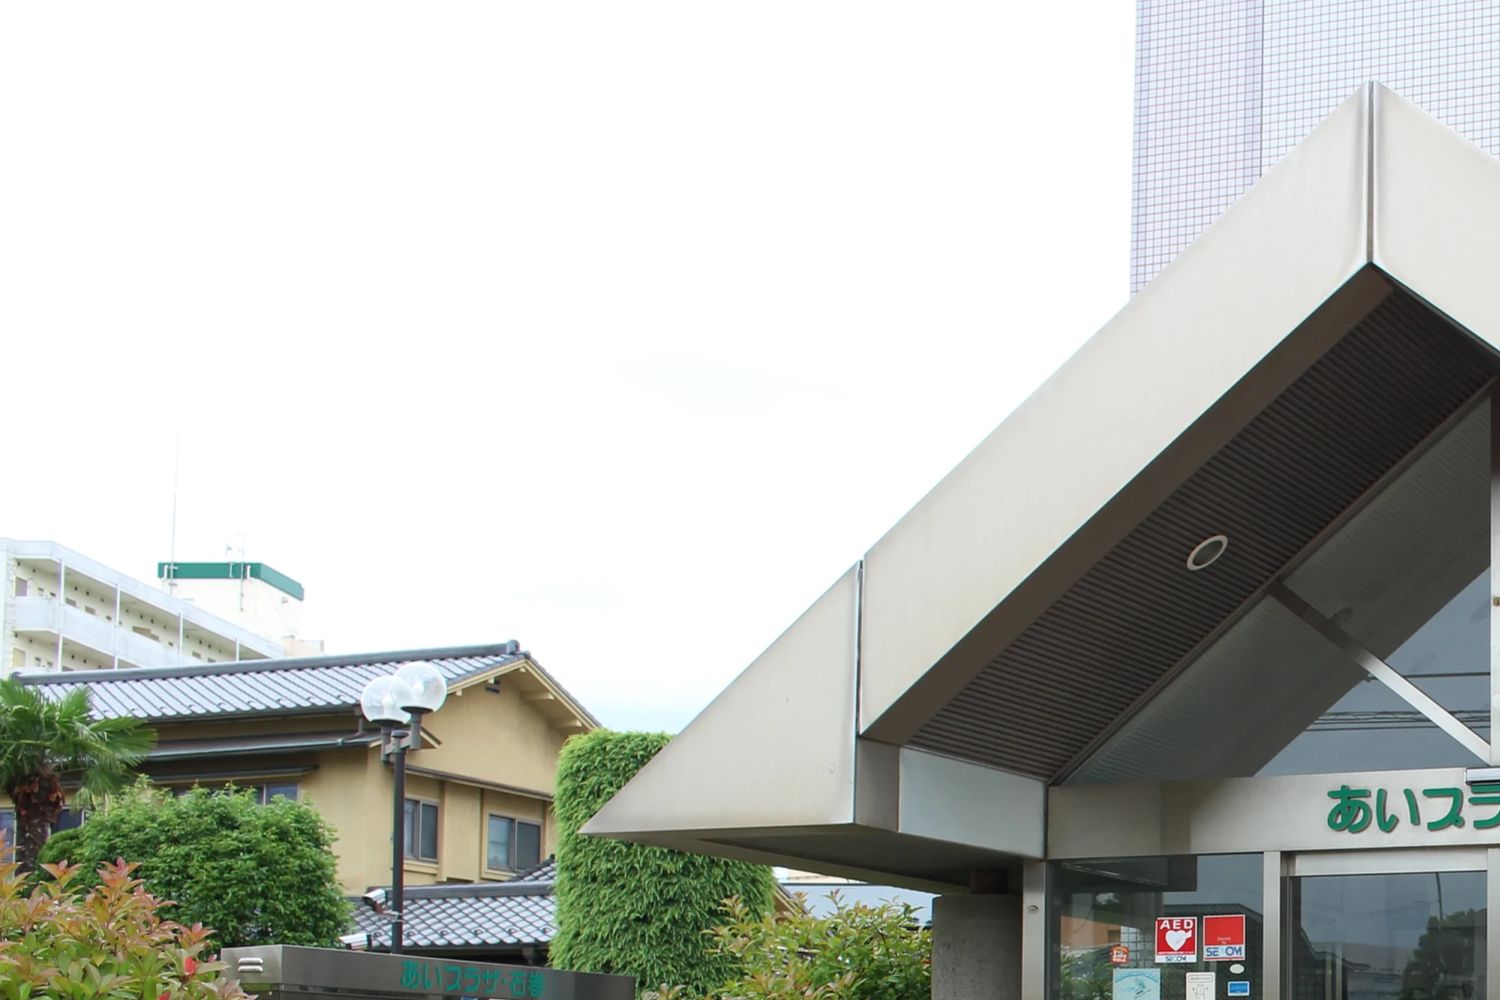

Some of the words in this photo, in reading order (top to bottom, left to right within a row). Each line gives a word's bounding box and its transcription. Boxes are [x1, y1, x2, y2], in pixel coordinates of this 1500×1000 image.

[1160, 919, 1193, 930] AED
[1206, 946, 1242, 957] SEOM
[401, 961, 544, 997] あいプラザ・石巻
